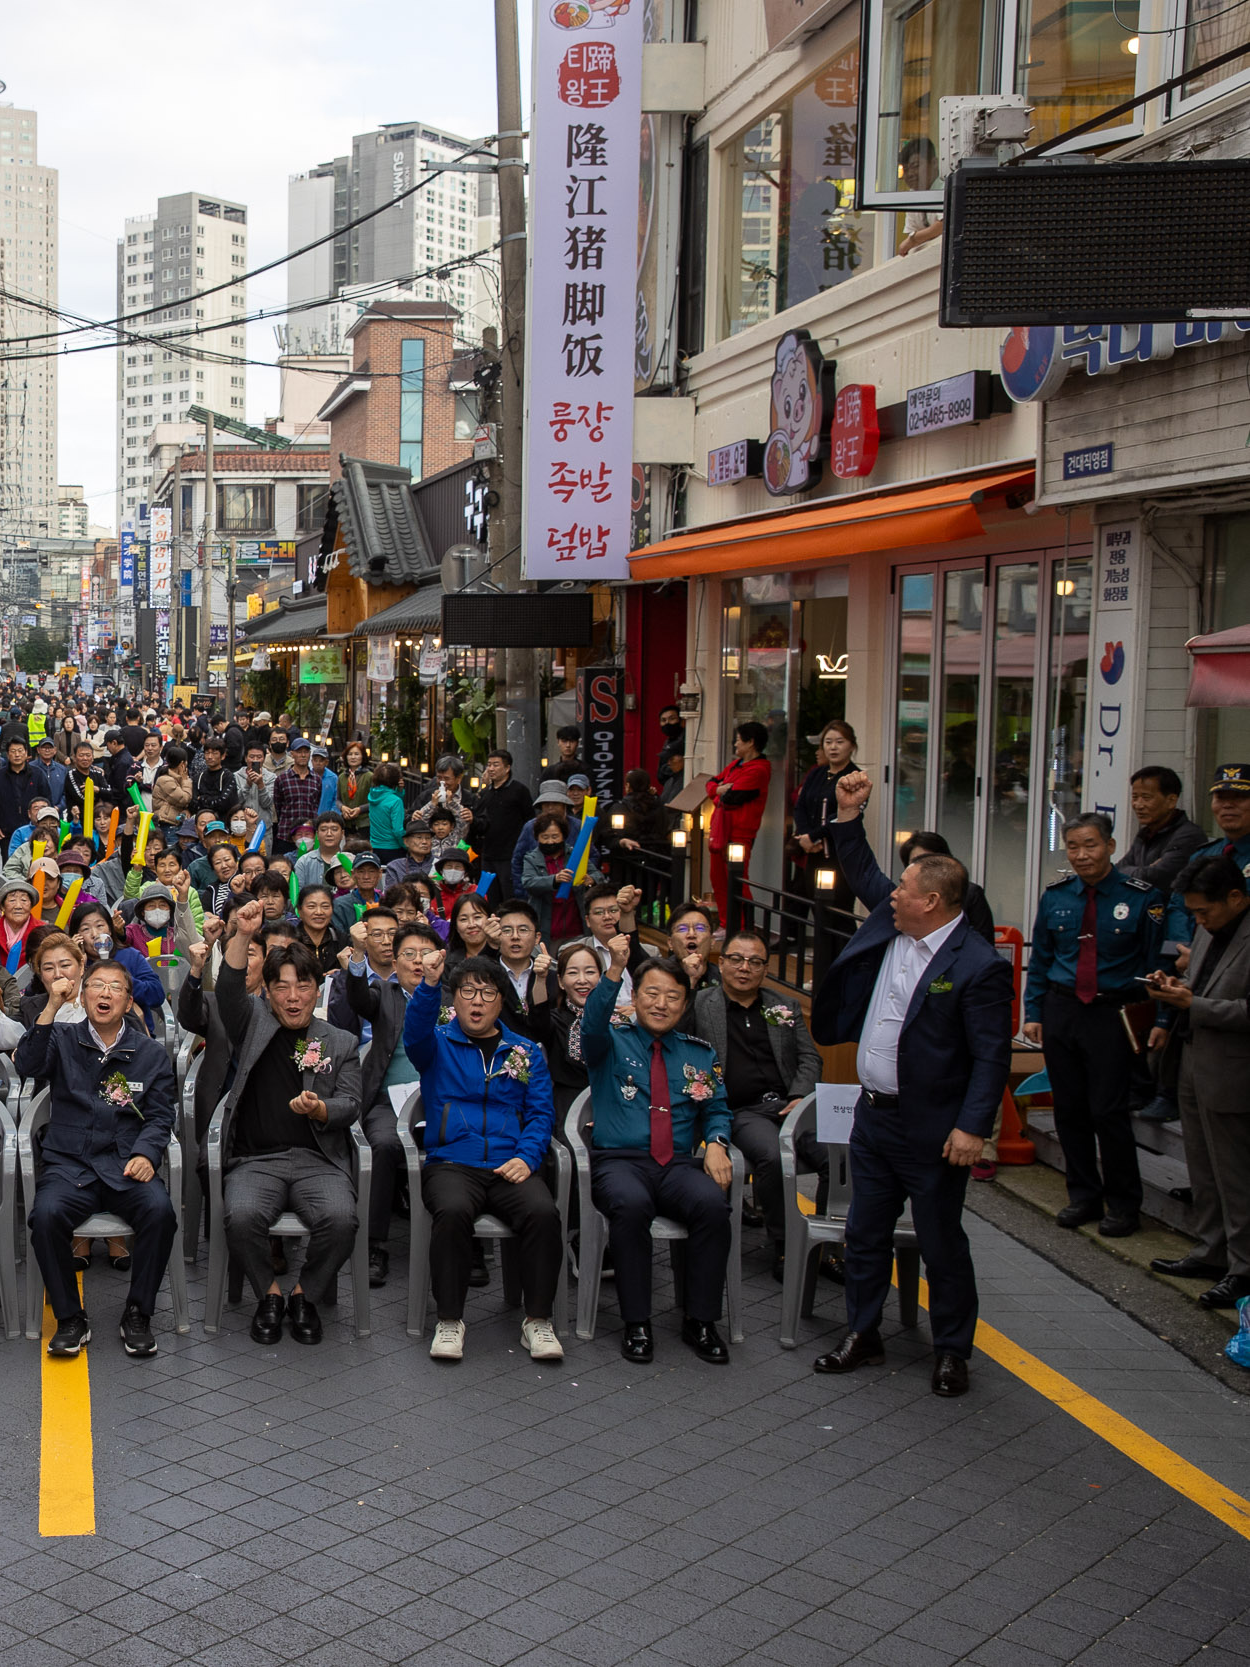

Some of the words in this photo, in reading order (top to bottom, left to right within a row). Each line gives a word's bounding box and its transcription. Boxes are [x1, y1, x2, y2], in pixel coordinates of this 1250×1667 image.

[910, 387, 942, 409] 예약문의
[909, 398, 971, 432] 02-6465-8999
[1066, 448, 1109, 475] 건대직영점
[548, 461, 613, 504] 족발
[547, 523, 611, 562] 덮밥
[1106, 531, 1132, 547] 피부과
[1110, 549, 1126, 565] 전용
[1103, 586, 1128, 602] 화장품
[590, 675, 619, 722] S
[1098, 702, 1121, 778] Dr.
